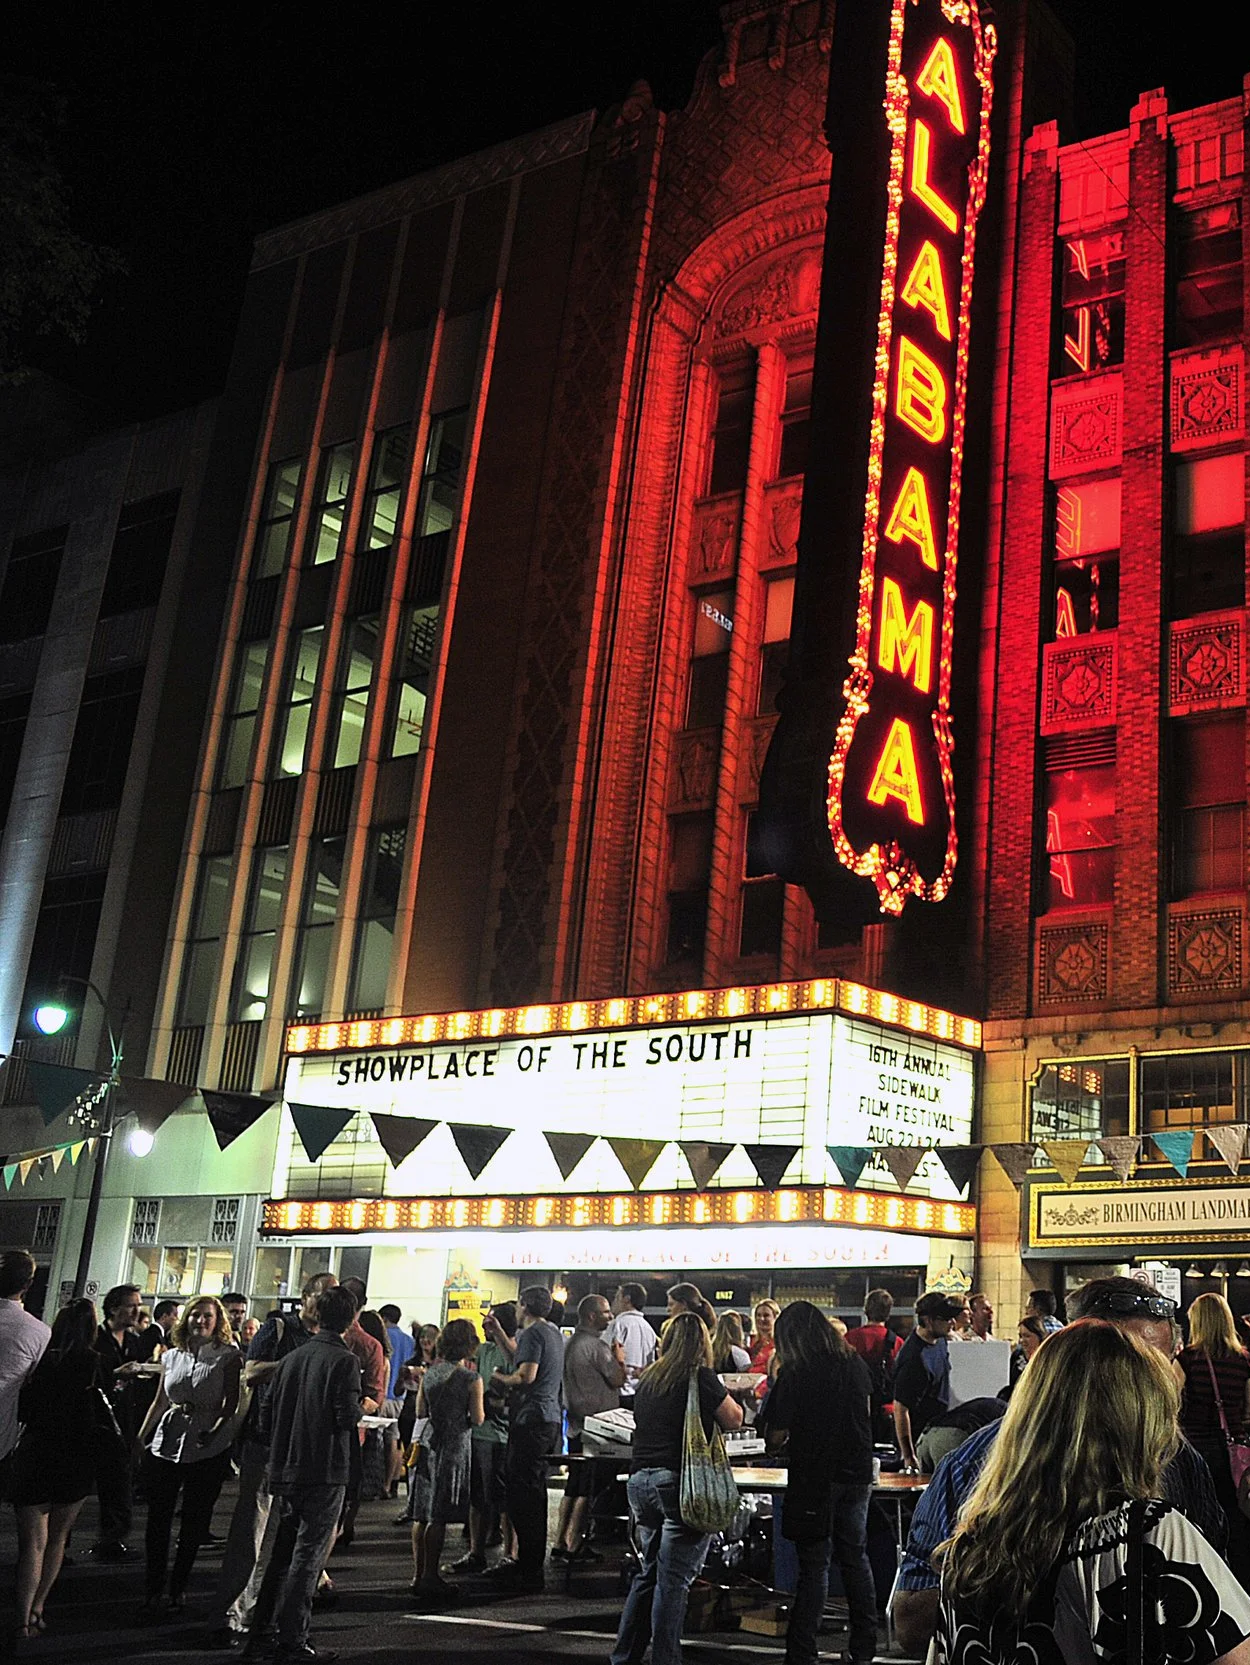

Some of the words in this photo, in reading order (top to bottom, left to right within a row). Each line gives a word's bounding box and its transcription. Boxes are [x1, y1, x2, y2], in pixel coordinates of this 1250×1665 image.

[867, 37, 965, 826] ALABAMA
[337, 1050, 498, 1086] SHOWPLACE
[517, 1045, 551, 1073] OF
[573, 1040, 627, 1070] THE
[645, 1029, 752, 1065] SOUTH
[868, 1044, 898, 1067] 16TH
[903, 1053, 951, 1081] ANNUAL
[878, 1074, 941, 1103] SIDEWALK
[859, 1096, 889, 1118] FILM
[896, 1104, 955, 1132] FESTIVAL
[1102, 1201, 1187, 1224] BIRMINGHAM
